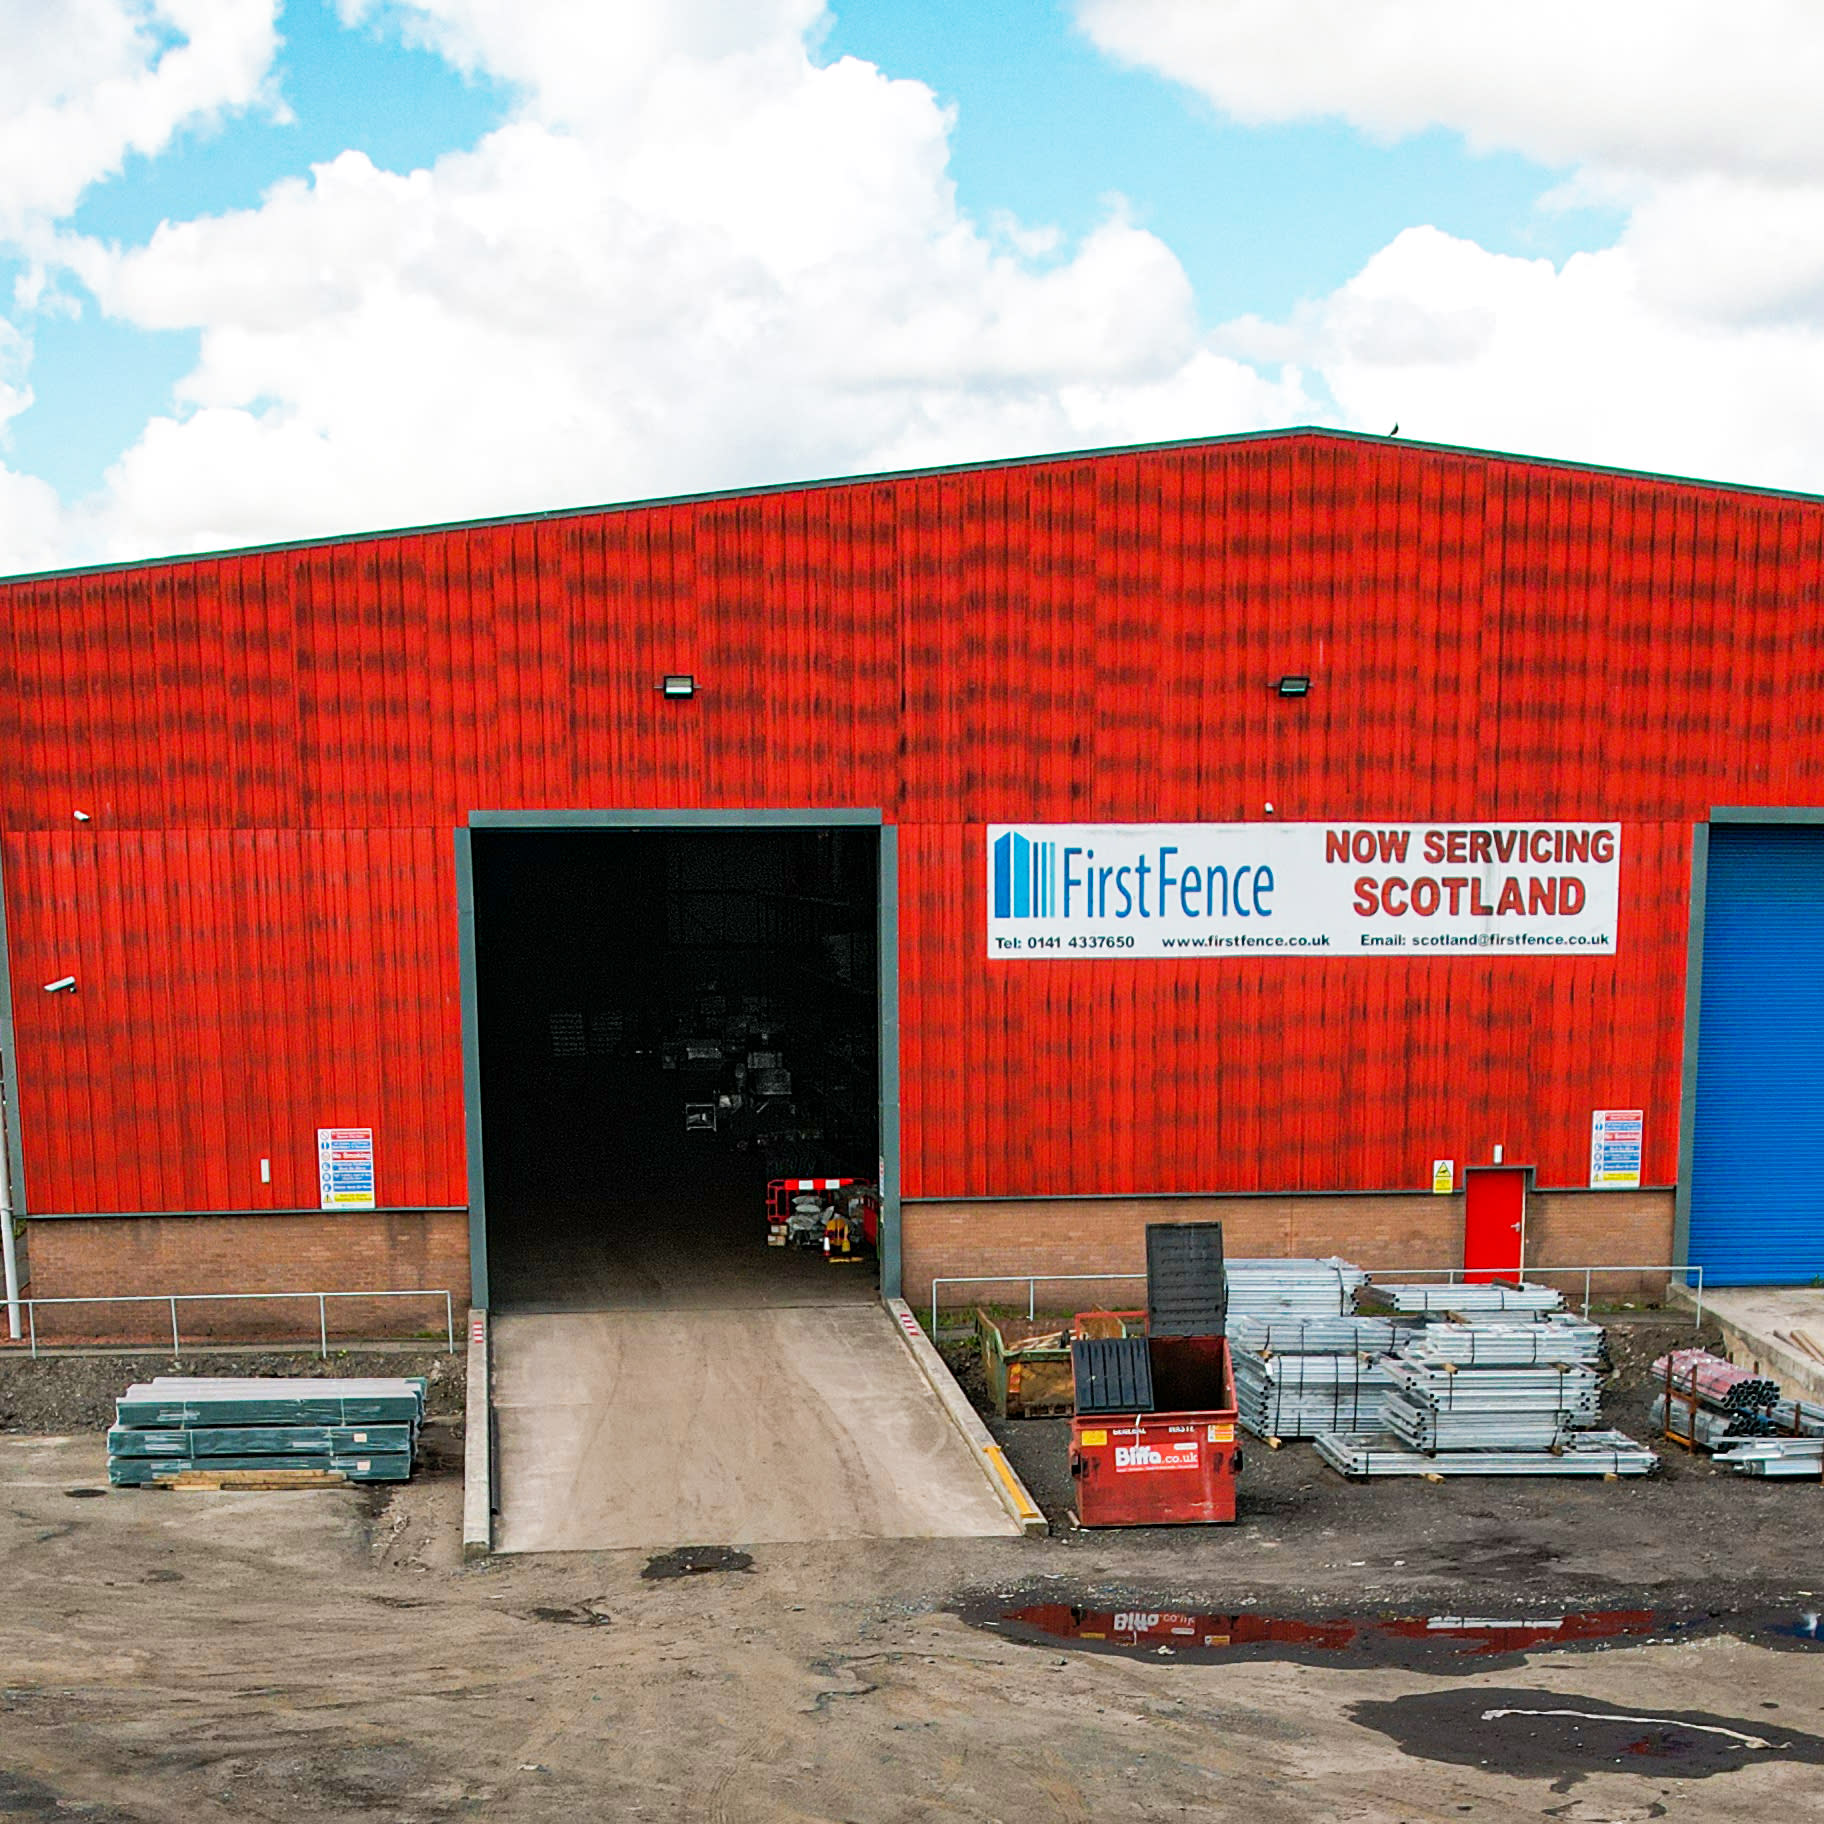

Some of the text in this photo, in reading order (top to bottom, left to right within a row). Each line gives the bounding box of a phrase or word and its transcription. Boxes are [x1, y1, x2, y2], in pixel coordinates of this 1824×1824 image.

[1325, 829, 1615, 864] NOW SERVICING
[1063, 846, 1275, 919] FirstFence
[1352, 876, 1587, 917] SCOTLAND
[995, 935, 1135, 949] Tel: 0141 4337650
[1162, 934, 1330, 948] www.firstfence.co.uk
[1361, 933, 1609, 947] Email: scotland@firstfence.co.uk
